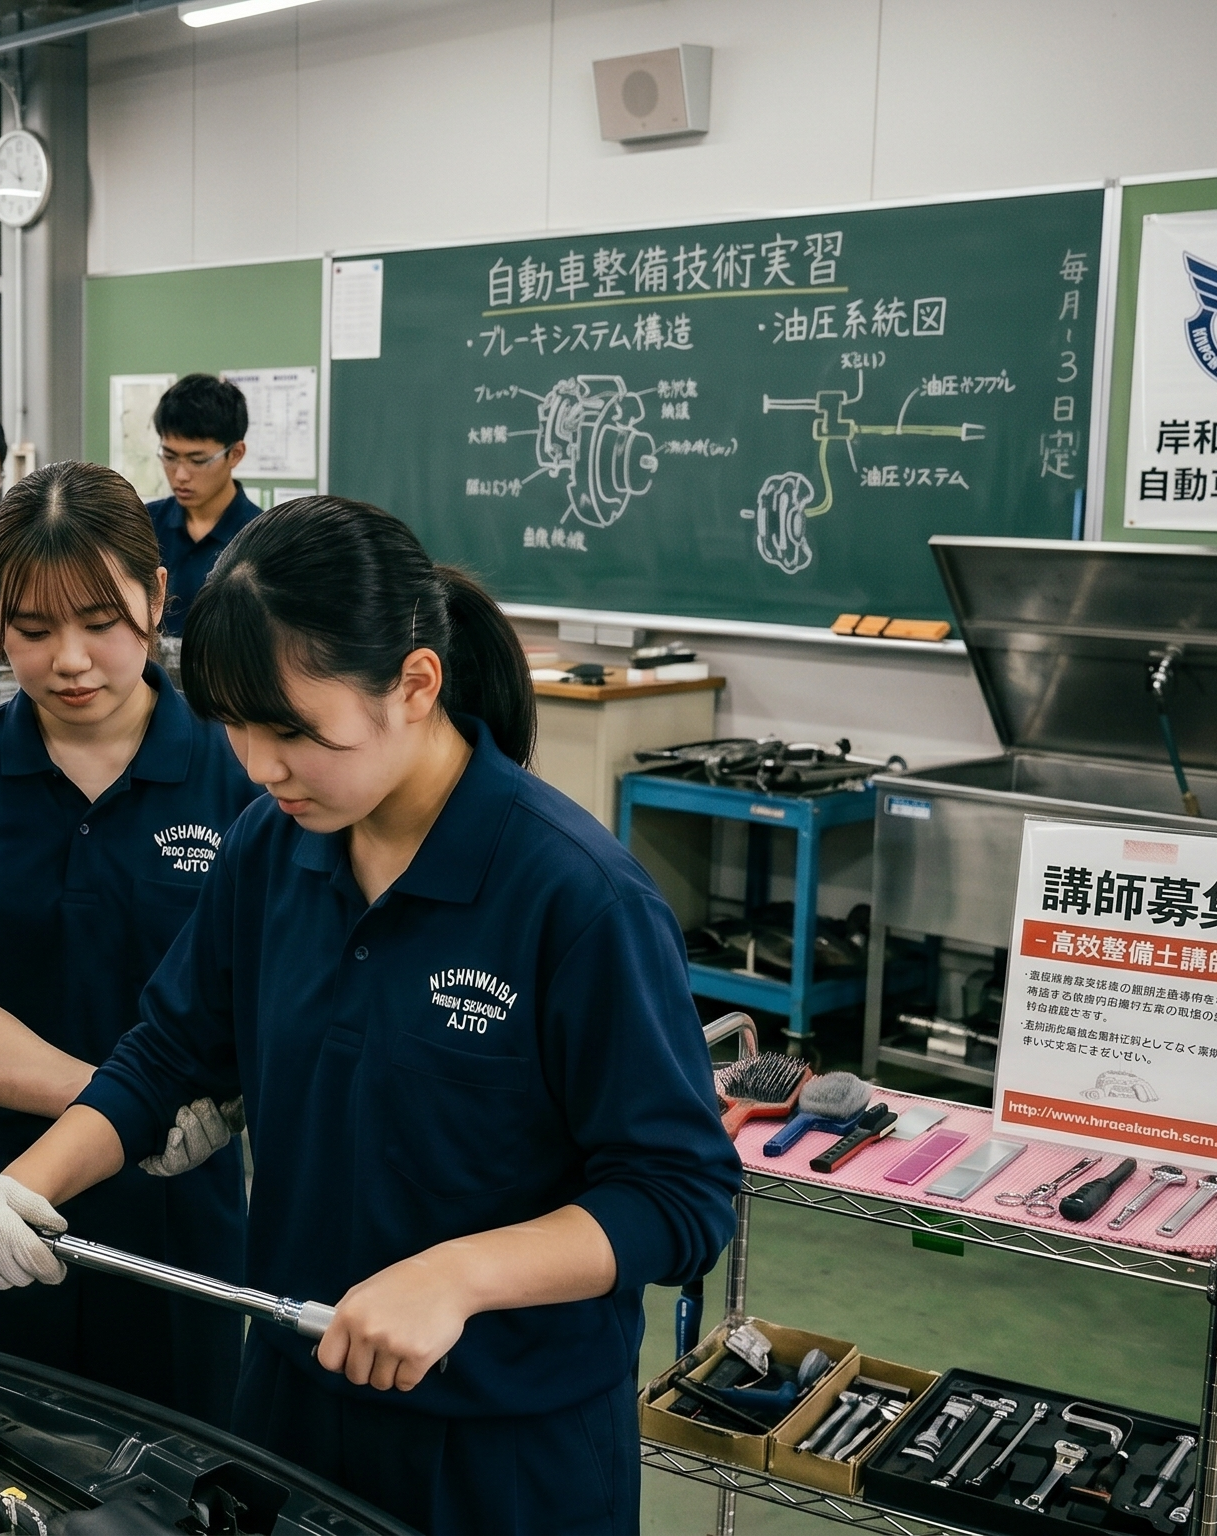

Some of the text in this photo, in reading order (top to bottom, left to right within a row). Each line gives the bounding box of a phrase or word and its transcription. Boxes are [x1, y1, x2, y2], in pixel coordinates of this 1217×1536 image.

[488, 231, 843, 307] 自動車整備技術実習
[1139, 466, 1217, 502] 自動
